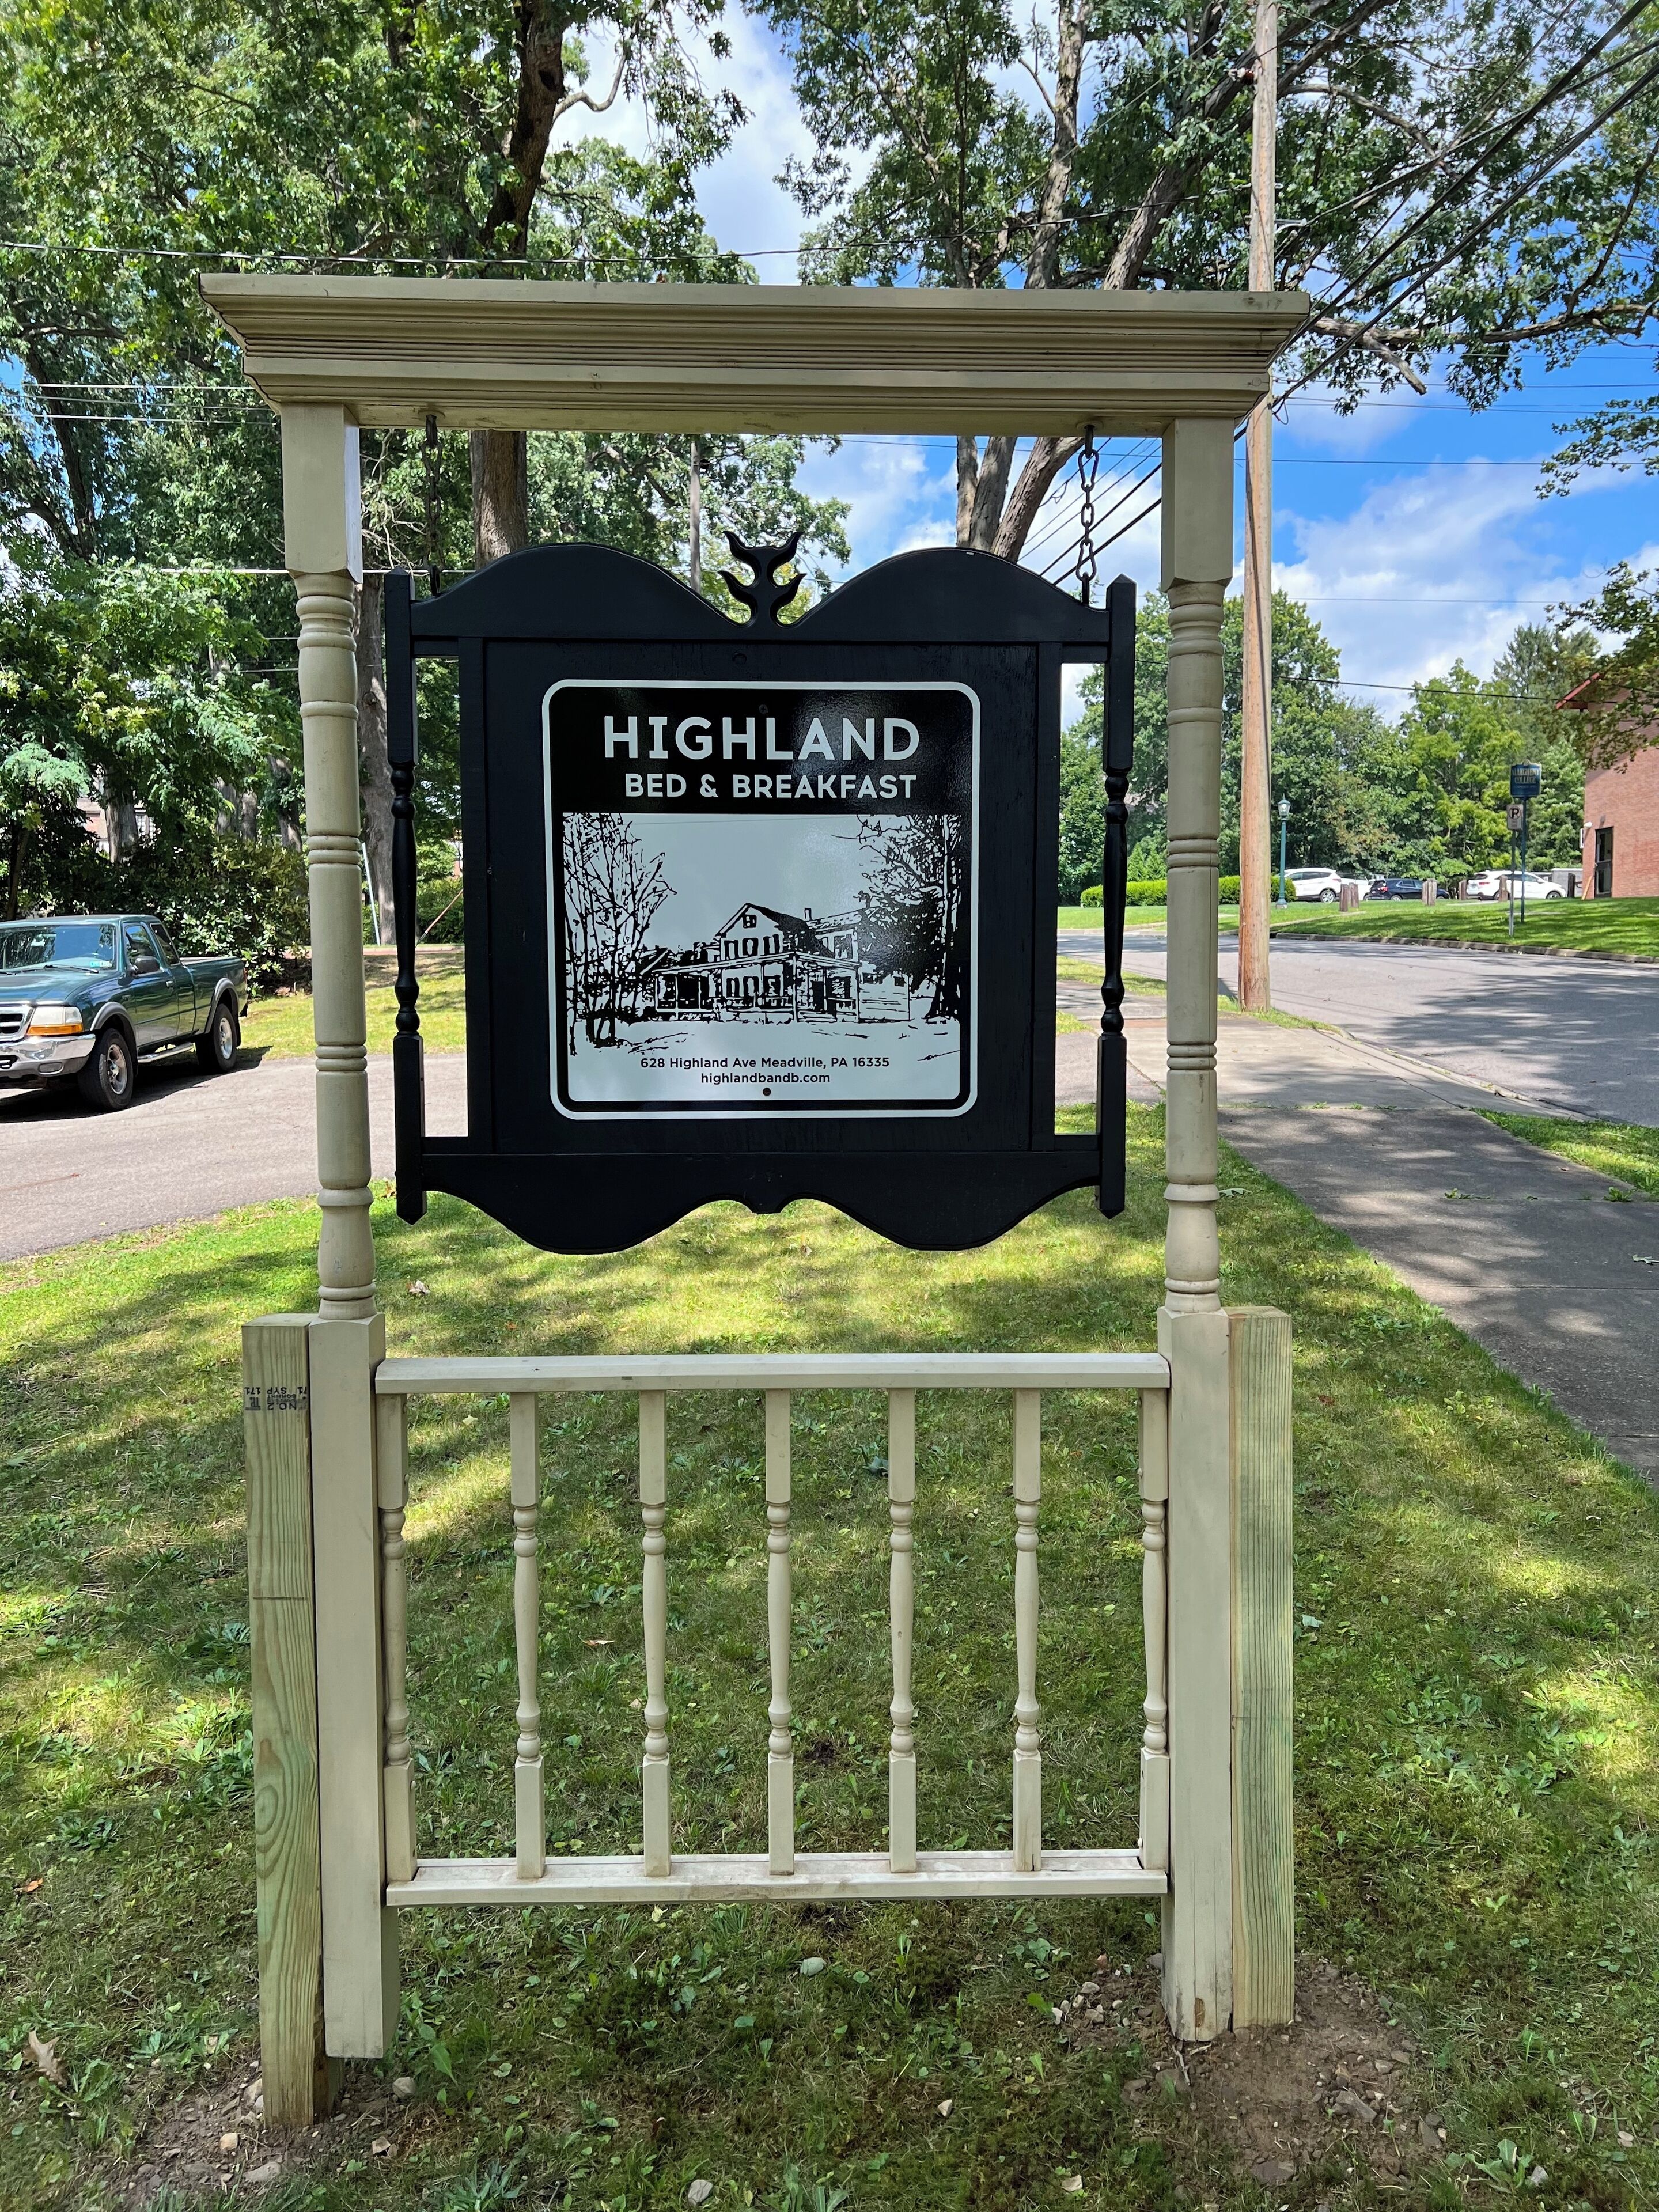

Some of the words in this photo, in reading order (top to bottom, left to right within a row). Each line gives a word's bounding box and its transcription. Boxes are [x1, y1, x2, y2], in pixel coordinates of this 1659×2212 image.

[604, 715, 920, 761] HIGHLAND
[625, 773, 687, 798] BED
[699, 774, 719, 798] &
[733, 774, 917, 799] BREAKFAST
[641, 1058, 665, 1068] 628
[670, 1057, 728, 1070] Highland
[732, 1058, 756, 1067] Ave
[761, 1057, 827, 1070] Meadville,
[831, 1057, 848, 1067] PA
[852, 1057, 890, 1067] 16335
[701, 1072, 830, 1085] highlandbandb.com
